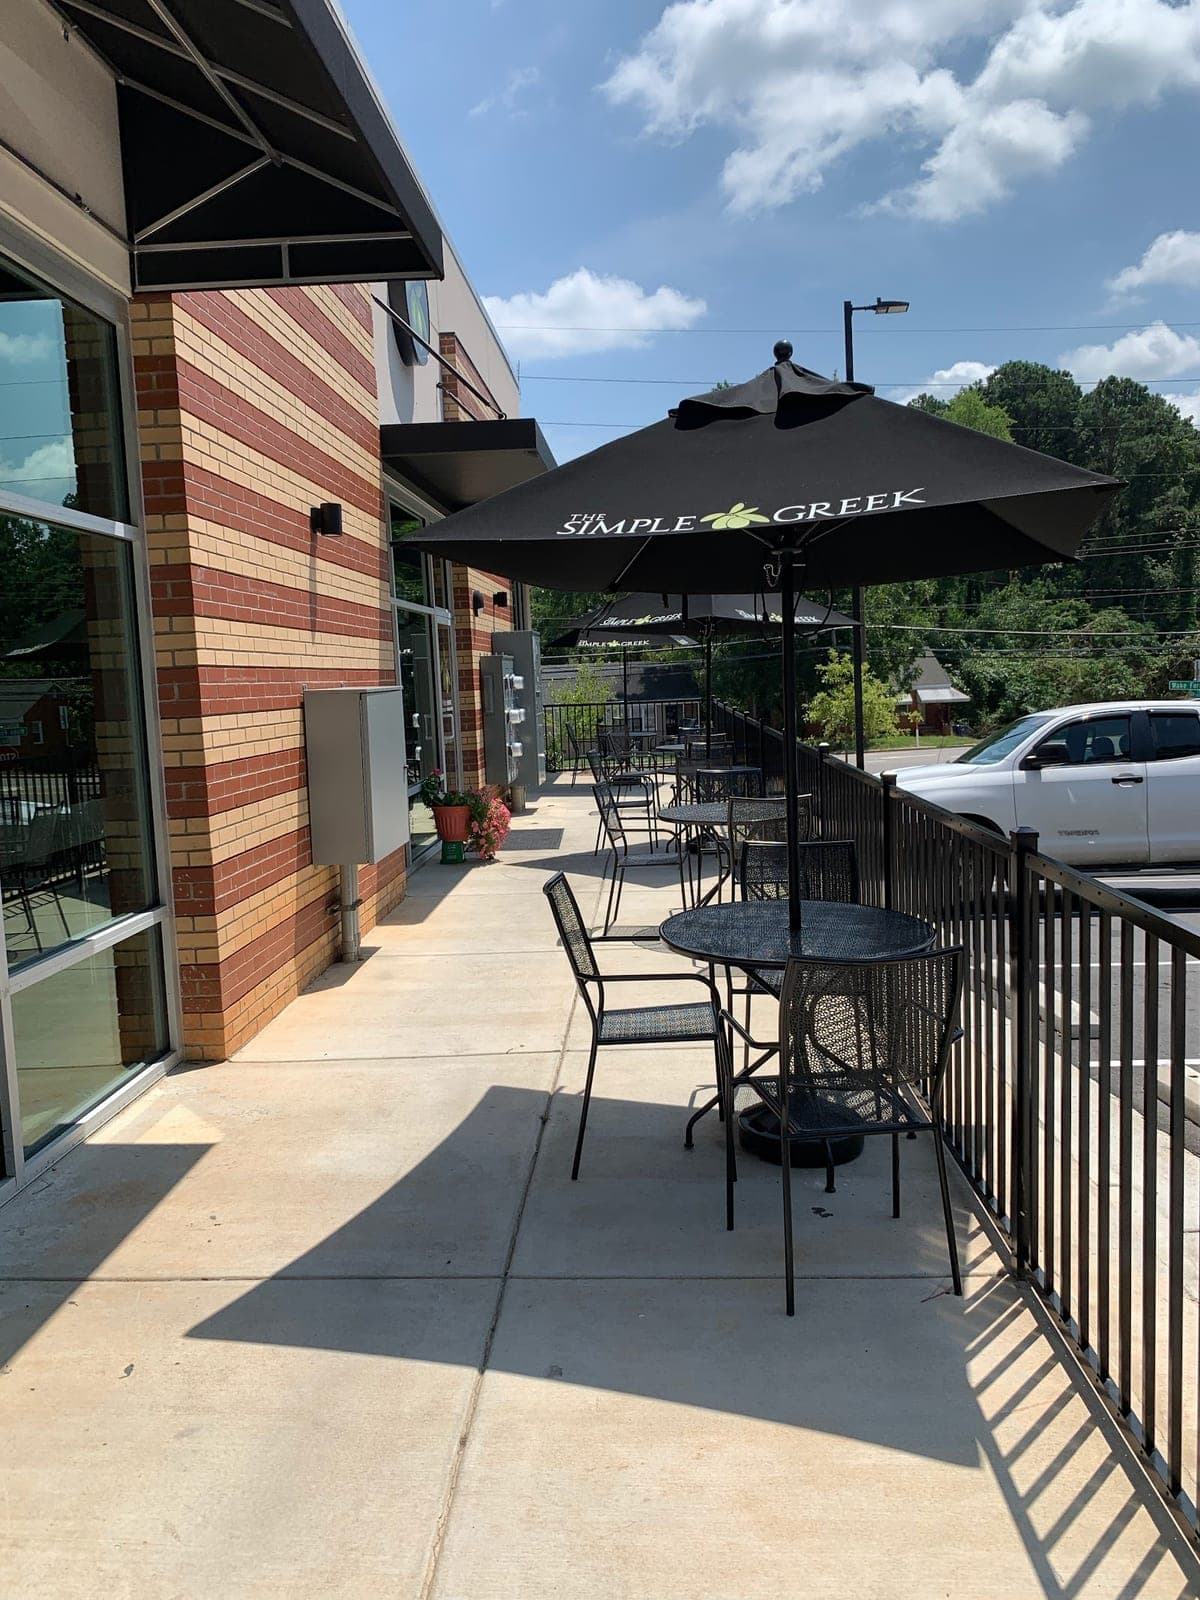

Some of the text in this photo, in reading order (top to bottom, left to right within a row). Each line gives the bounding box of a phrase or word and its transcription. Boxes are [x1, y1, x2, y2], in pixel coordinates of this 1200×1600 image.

[556, 487, 927, 535] SIMPLE GREEK
[570, 513, 607, 522] THE
